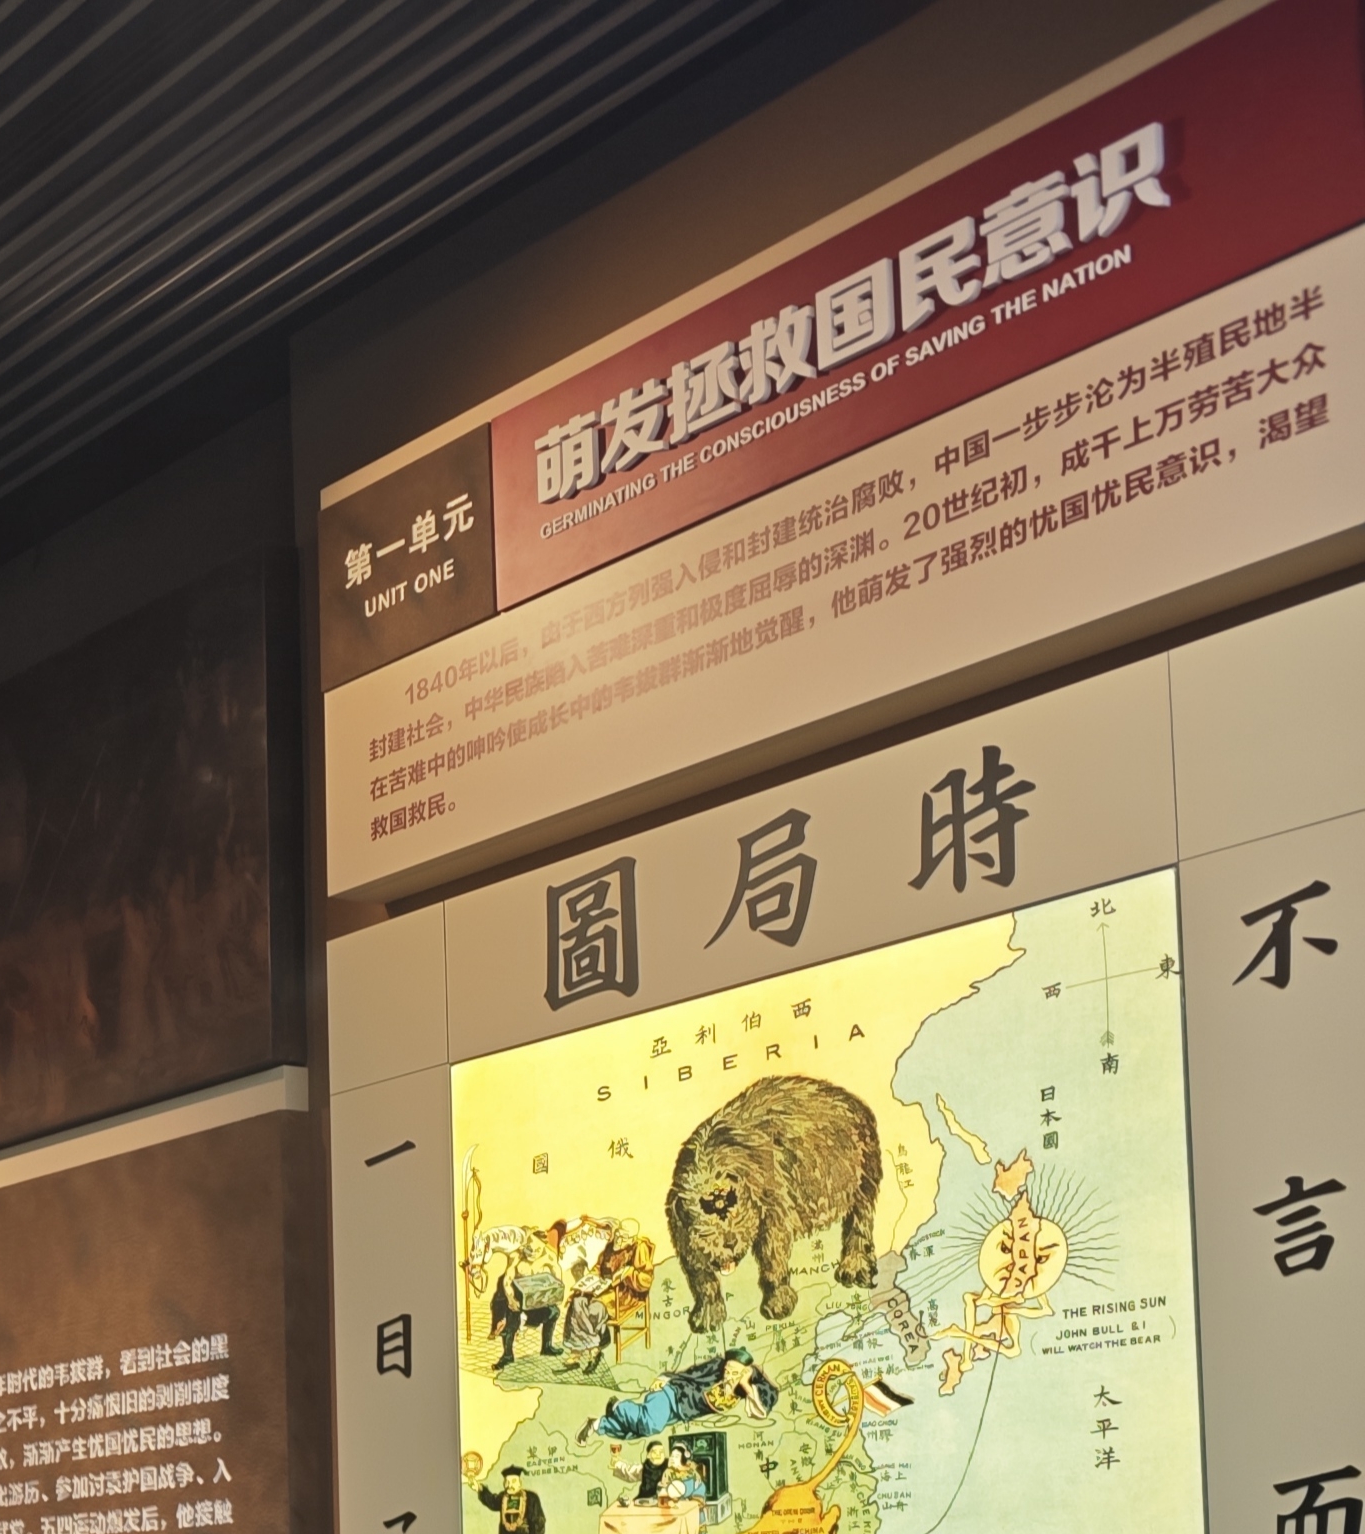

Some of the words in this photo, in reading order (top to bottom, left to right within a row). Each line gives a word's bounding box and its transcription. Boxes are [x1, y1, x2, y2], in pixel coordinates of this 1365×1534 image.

[534, 121, 1171, 505] 萌发拯救国民意识
[539, 472, 656, 540] GERMINATING
[659, 452, 695, 483] THE
[699, 372, 867, 465] CONSCIOUSNESS
[870, 354, 901, 384] OF
[904, 314, 986, 367] SAVING
[990, 289, 1037, 325] THE
[1041, 244, 1131, 303] NATION
[344, 492, 475, 590] 第一单元
[363, 580, 408, 618] UNIT
[414, 558, 456, 594] ONE
[370, 790, 457, 842] 救国救民。
[1089, 897, 1117, 918] 北
[1041, 981, 1063, 1000] 西
[1154, 953, 1181, 980] 東
[596, 1023, 866, 1102] SIBERIA
[1099, 1052, 1120, 1075] 南
[1014, 1216, 1031, 1288] JAPAN
[887, 1297, 919, 1355] COREA
[1055, 1328, 1089, 1341] JOHN
[1092, 1324, 1124, 1337] BULL
[1062, 1307, 1088, 1320] THE
[1092, 1300, 1136, 1315] RISING
[1139, 1295, 1167, 1310] SUN
[1042, 1346, 1064, 1355] WILL
[1068, 1341, 1103, 1353] WATCH
[1104, 1338, 1127, 1349] THE
[1129, 1334, 1161, 1346] BEAR
[1090, 1384, 1123, 1470] 太平洋
